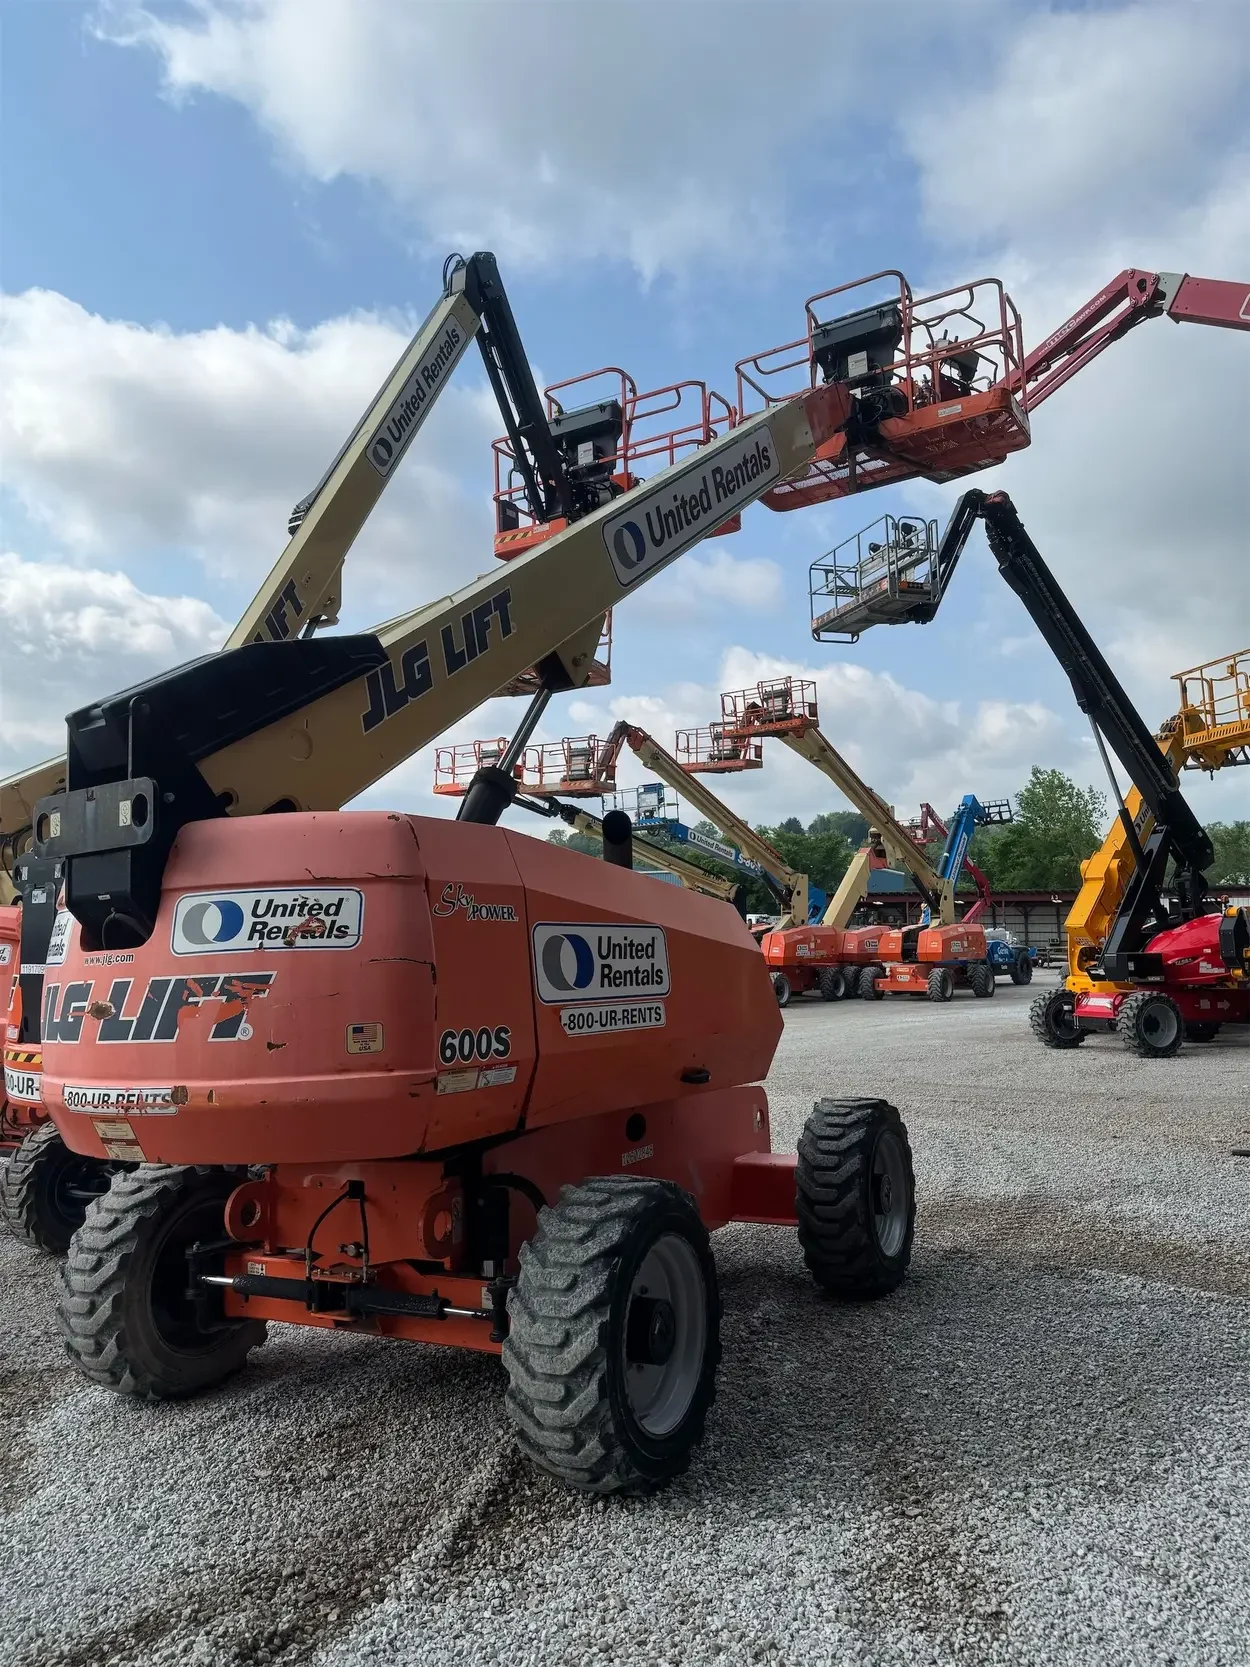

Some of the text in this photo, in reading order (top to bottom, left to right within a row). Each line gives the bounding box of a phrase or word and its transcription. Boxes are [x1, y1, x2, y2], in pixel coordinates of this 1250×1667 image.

[386, 328, 461, 443] United Rentals
[645, 441, 772, 548] United Rentals
[253, 577, 304, 643] IFT
[360, 586, 514, 735] JLG LIFT
[696, 835, 733, 858] United Rentals
[250, 897, 345, 919] United
[432, 882, 515, 922] Sky POWER
[84, 953, 134, 967] www.jlg.com
[597, 935, 656, 961] United
[599, 962, 664, 989] Rentals
[96, 971, 277, 1044] LIFT
[439, 1024, 512, 1066] 600S
